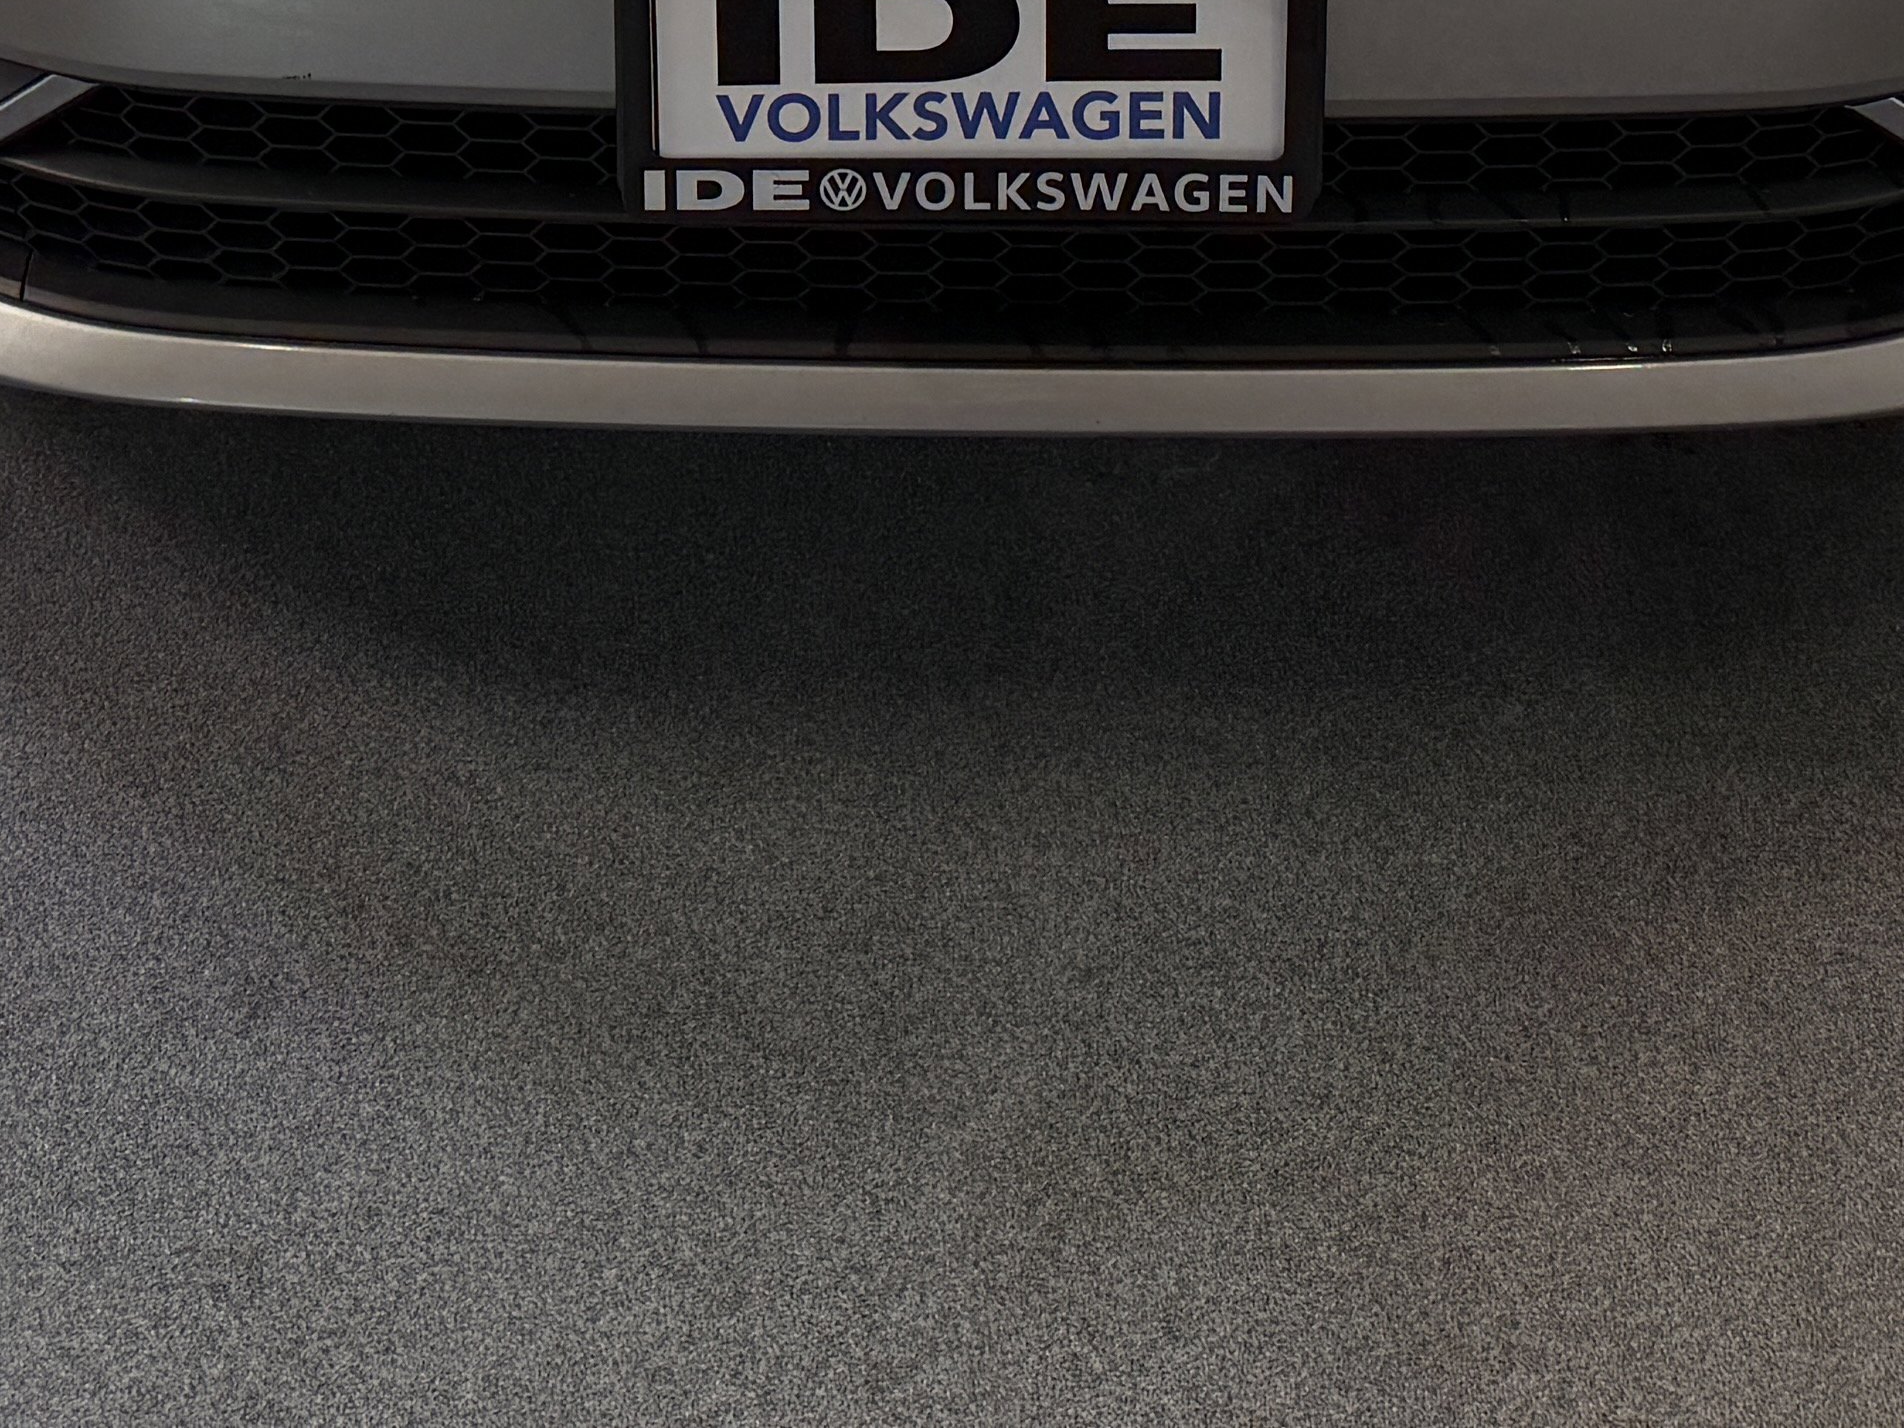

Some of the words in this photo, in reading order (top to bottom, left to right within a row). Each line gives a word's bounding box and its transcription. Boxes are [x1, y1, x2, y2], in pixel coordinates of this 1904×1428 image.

[715, 91, 1222, 143] VOLKSWAGEN
[643, 169, 811, 211] IDE
[872, 171, 1294, 214] VOLKSWAGEN
